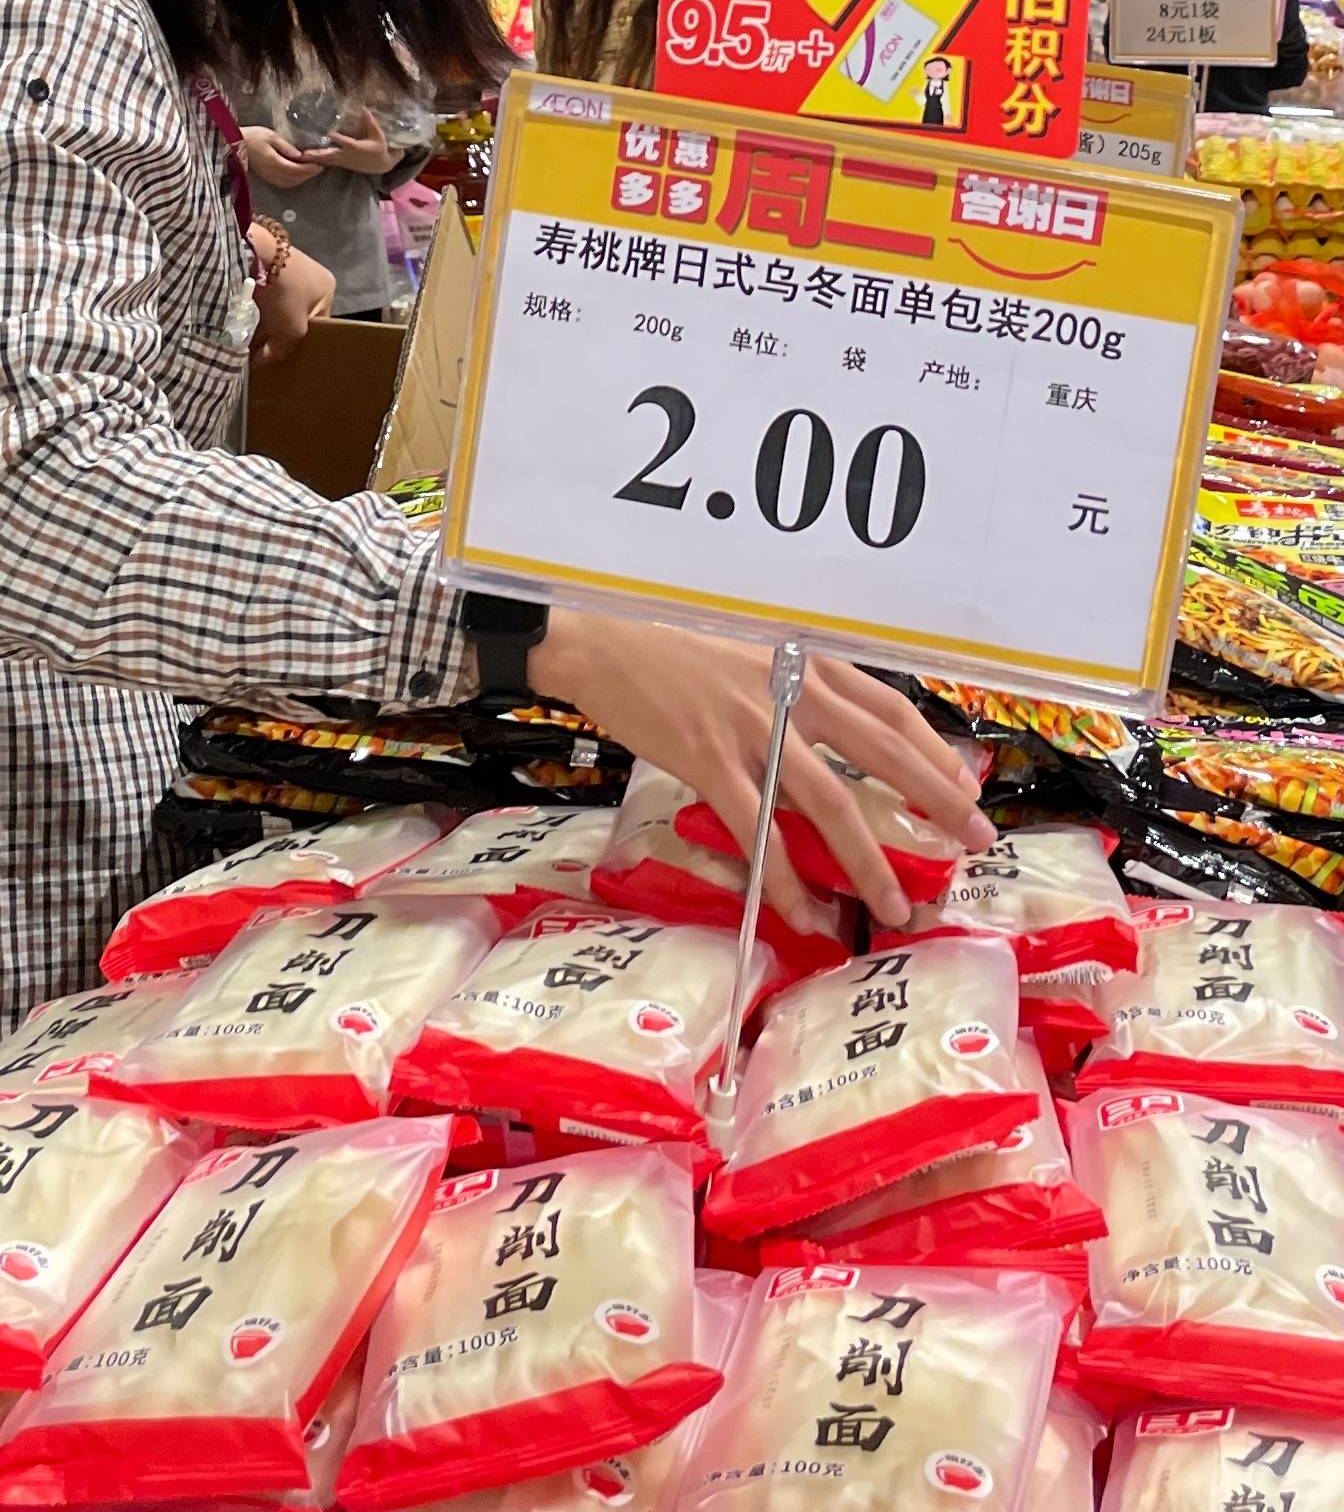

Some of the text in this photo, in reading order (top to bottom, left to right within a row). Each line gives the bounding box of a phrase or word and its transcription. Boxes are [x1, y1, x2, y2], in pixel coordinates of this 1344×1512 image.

[1146, 25, 1217, 44] 24元1板
[1159, 0, 1220, 20] 8元1袋
[618, 170, 706, 216] 多多
[623, 123, 715, 168] 优惠
[716, 130, 938, 257] 周二
[959, 174, 1100, 243] 答谢日
[532, 219, 1127, 361] 寿桃牌日式乌冬面单包装200g
[632, 313, 685, 345] 200g
[842, 345, 868, 373] 袋
[1045, 383, 1099, 413] 重庆
[612, 383, 929, 551] 2.00
[1067, 493, 1111, 536] 元
[245, 911, 378, 1015] 刀削面
[543, 925, 665, 992] 刀削面
[843, 953, 913, 1061] 刀削面
[1194, 917, 1255, 1003] 刀削面
[1191, 1114, 1276, 1256] 刀削面
[132, 1146, 300, 1332] 刀削面
[482, 1171, 567, 1321] 刀削面
[814, 1291, 926, 1453] 刀削面
